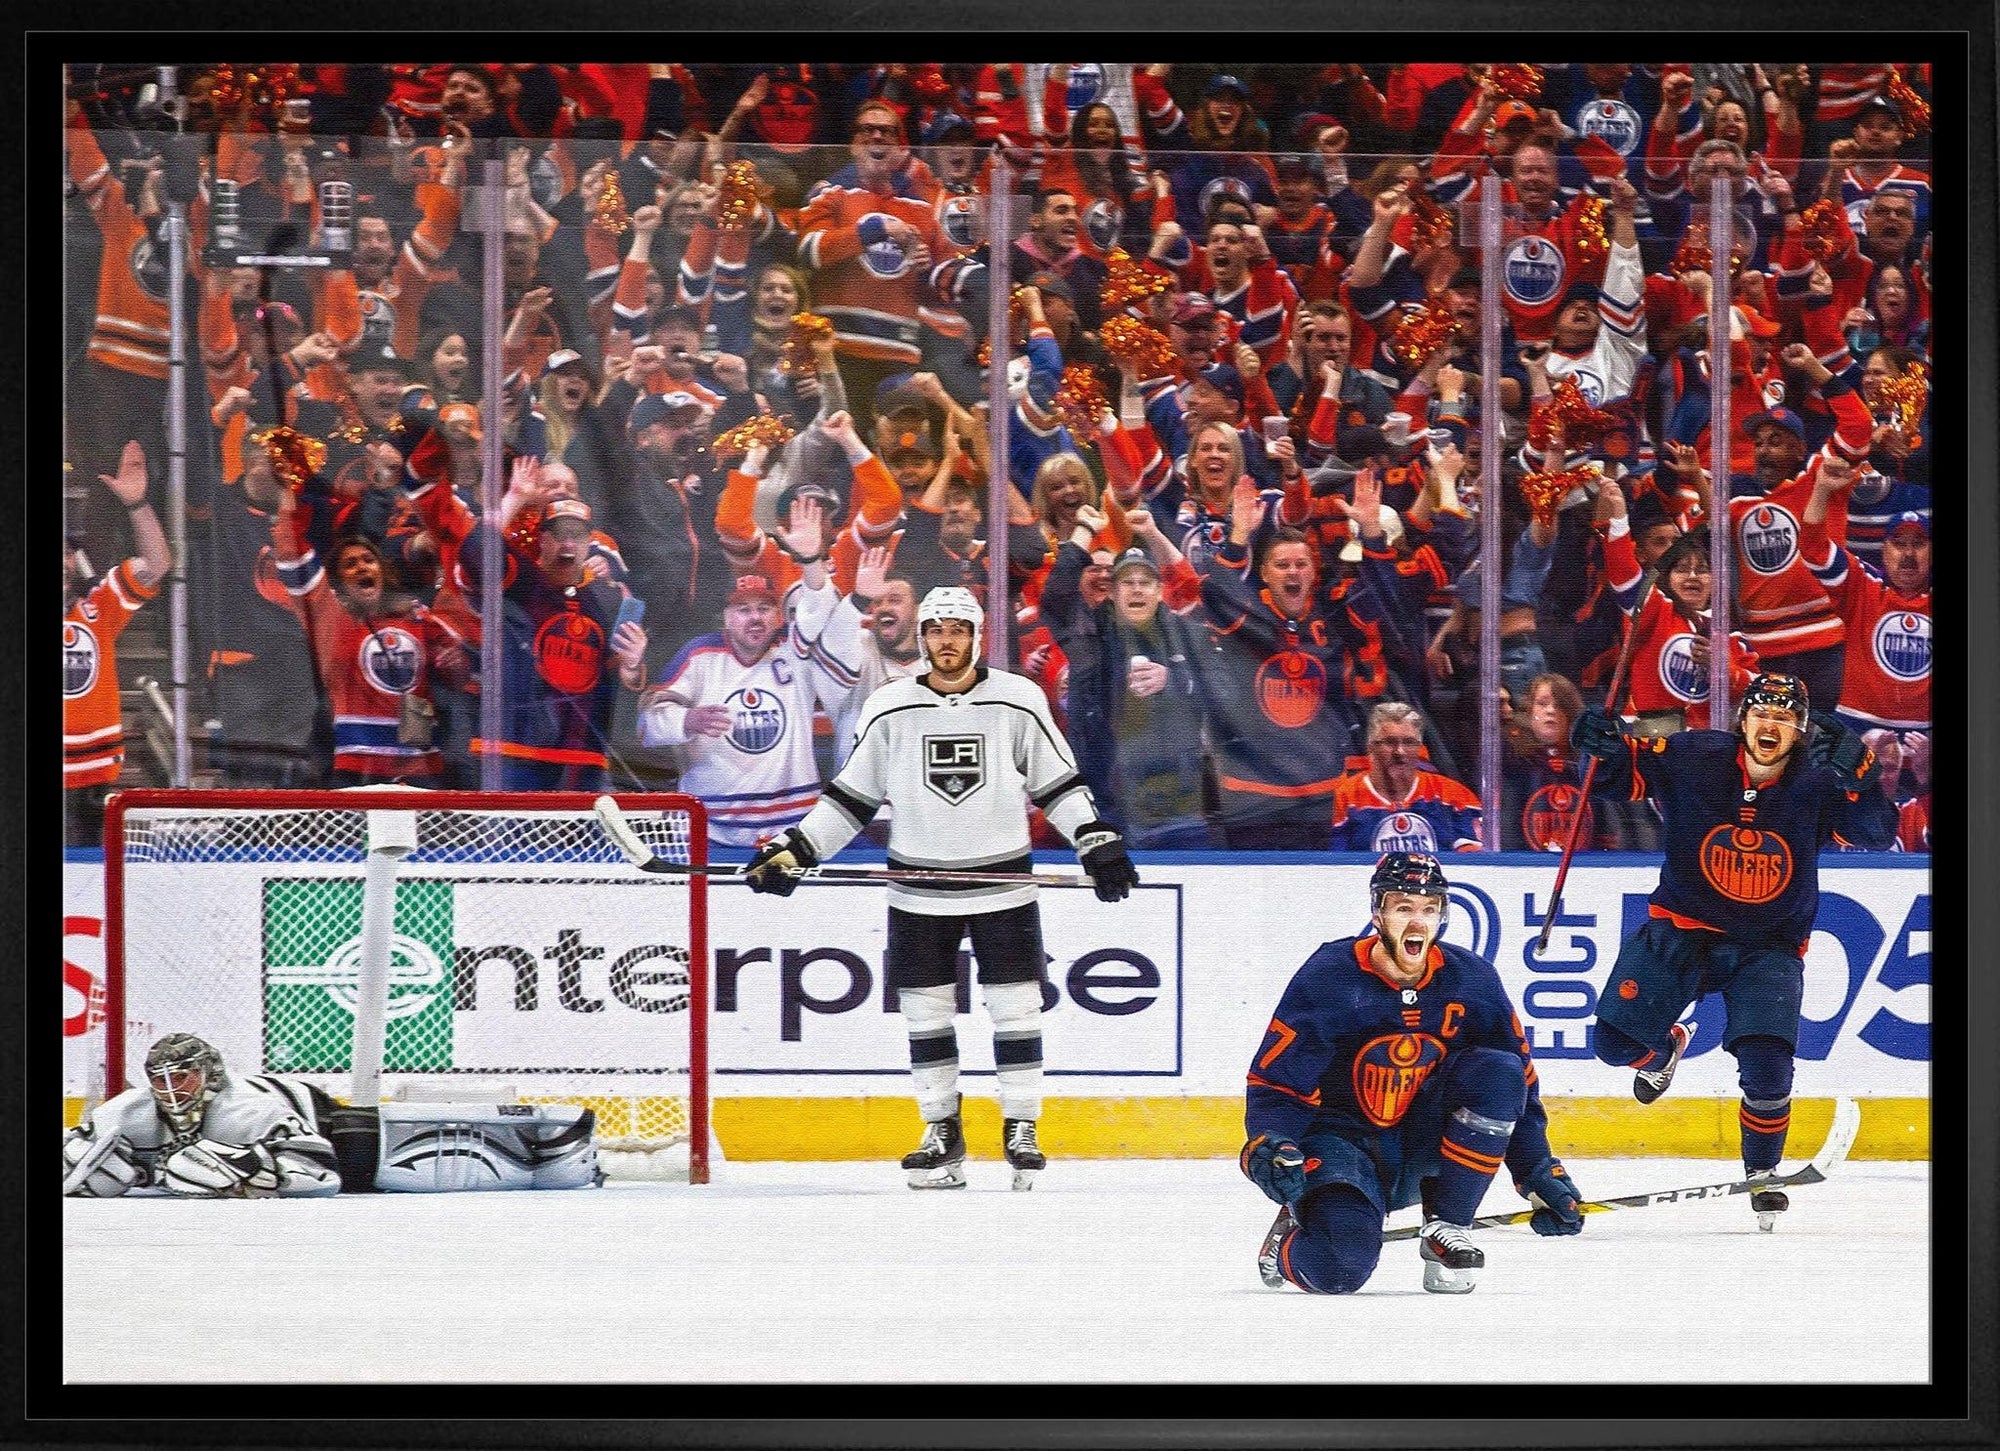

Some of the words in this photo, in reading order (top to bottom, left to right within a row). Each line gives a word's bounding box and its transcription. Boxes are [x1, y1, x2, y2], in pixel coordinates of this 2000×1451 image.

[1310, 620, 1328, 647] C
[771, 658, 792, 685] C
[931, 743, 978, 764] LA
[1711, 845, 1783, 884] OILERS
[1523, 892, 1598, 1060] EOCF
[1440, 1003, 1466, 1038] C
[1648, 1183, 1733, 1208] CCM
